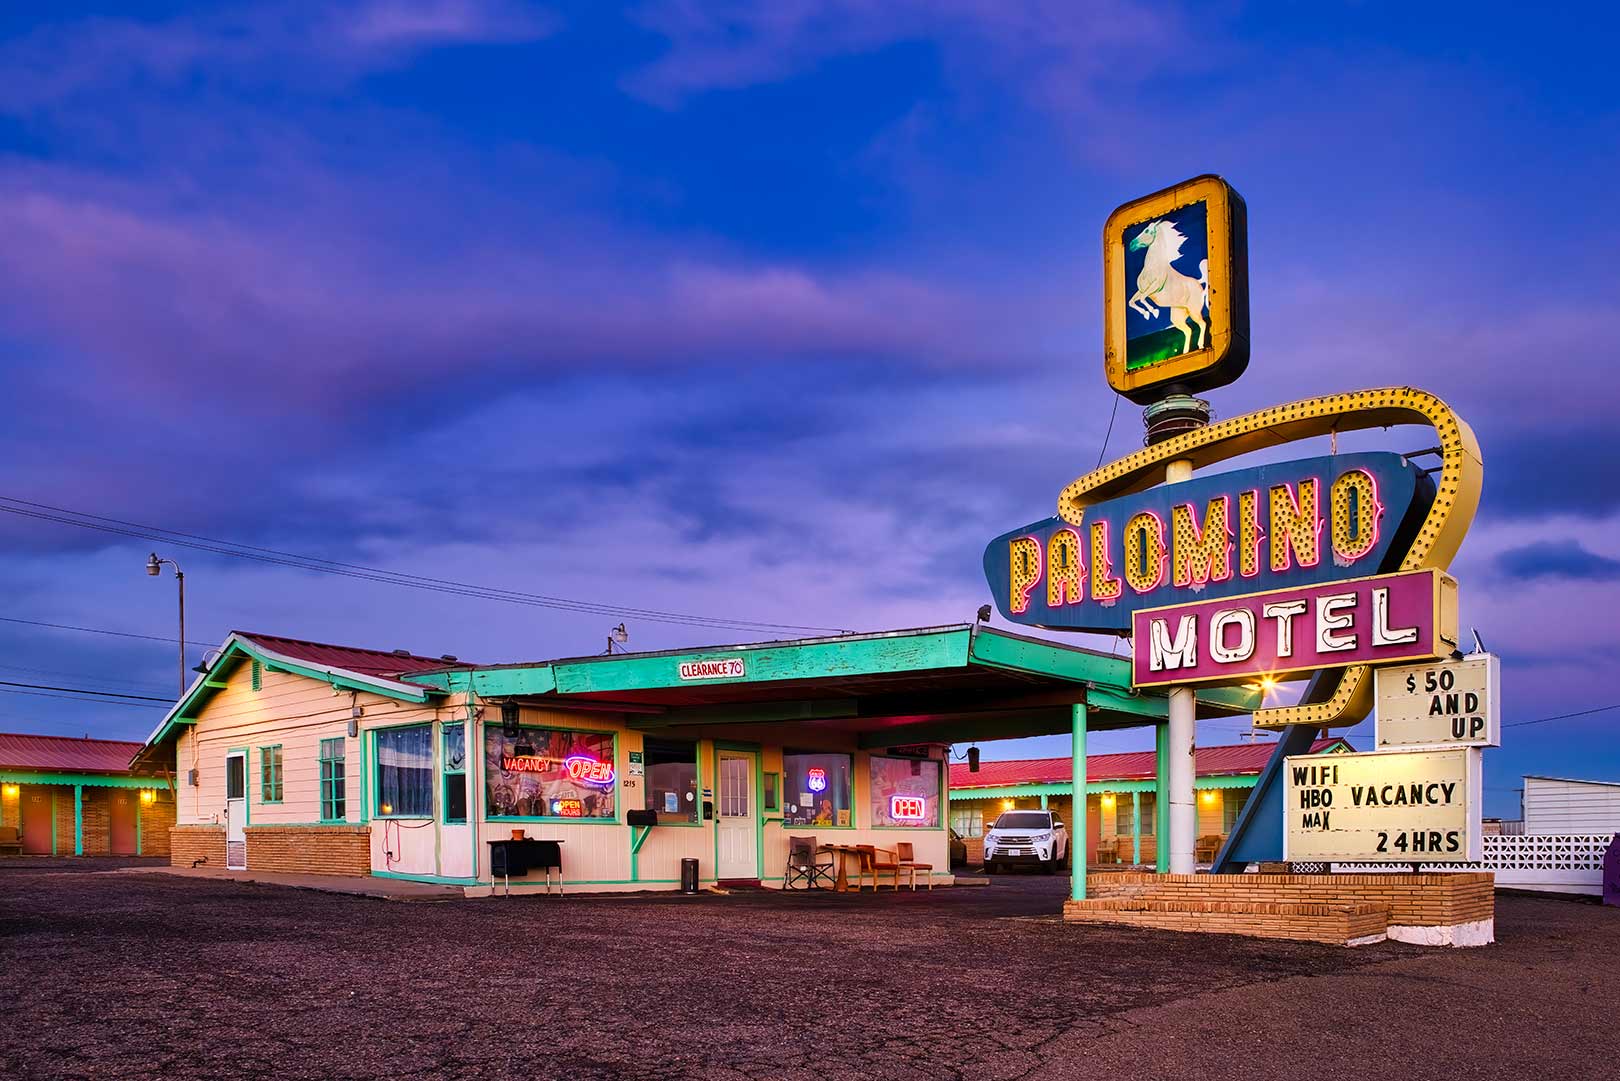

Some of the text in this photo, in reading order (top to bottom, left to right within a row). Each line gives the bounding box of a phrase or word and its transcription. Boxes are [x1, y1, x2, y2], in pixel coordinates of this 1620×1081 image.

[1009, 468, 1384, 614] PALOMINO
[1149, 587, 1418, 672] MOTEL
[681, 663, 727, 677] CLEARANCE
[1429, 693, 1479, 716] AND
[1451, 717, 1484, 738] UP
[503, 758, 550, 771] VACANCY
[569, 760, 611, 779] OPEN
[1292, 765, 1339, 786] WIFI
[1300, 788, 1333, 809] HBO
[1351, 782, 1456, 806] VACANCY
[894, 799, 923, 817] OPEN
[1302, 811, 1330, 831] MAX
